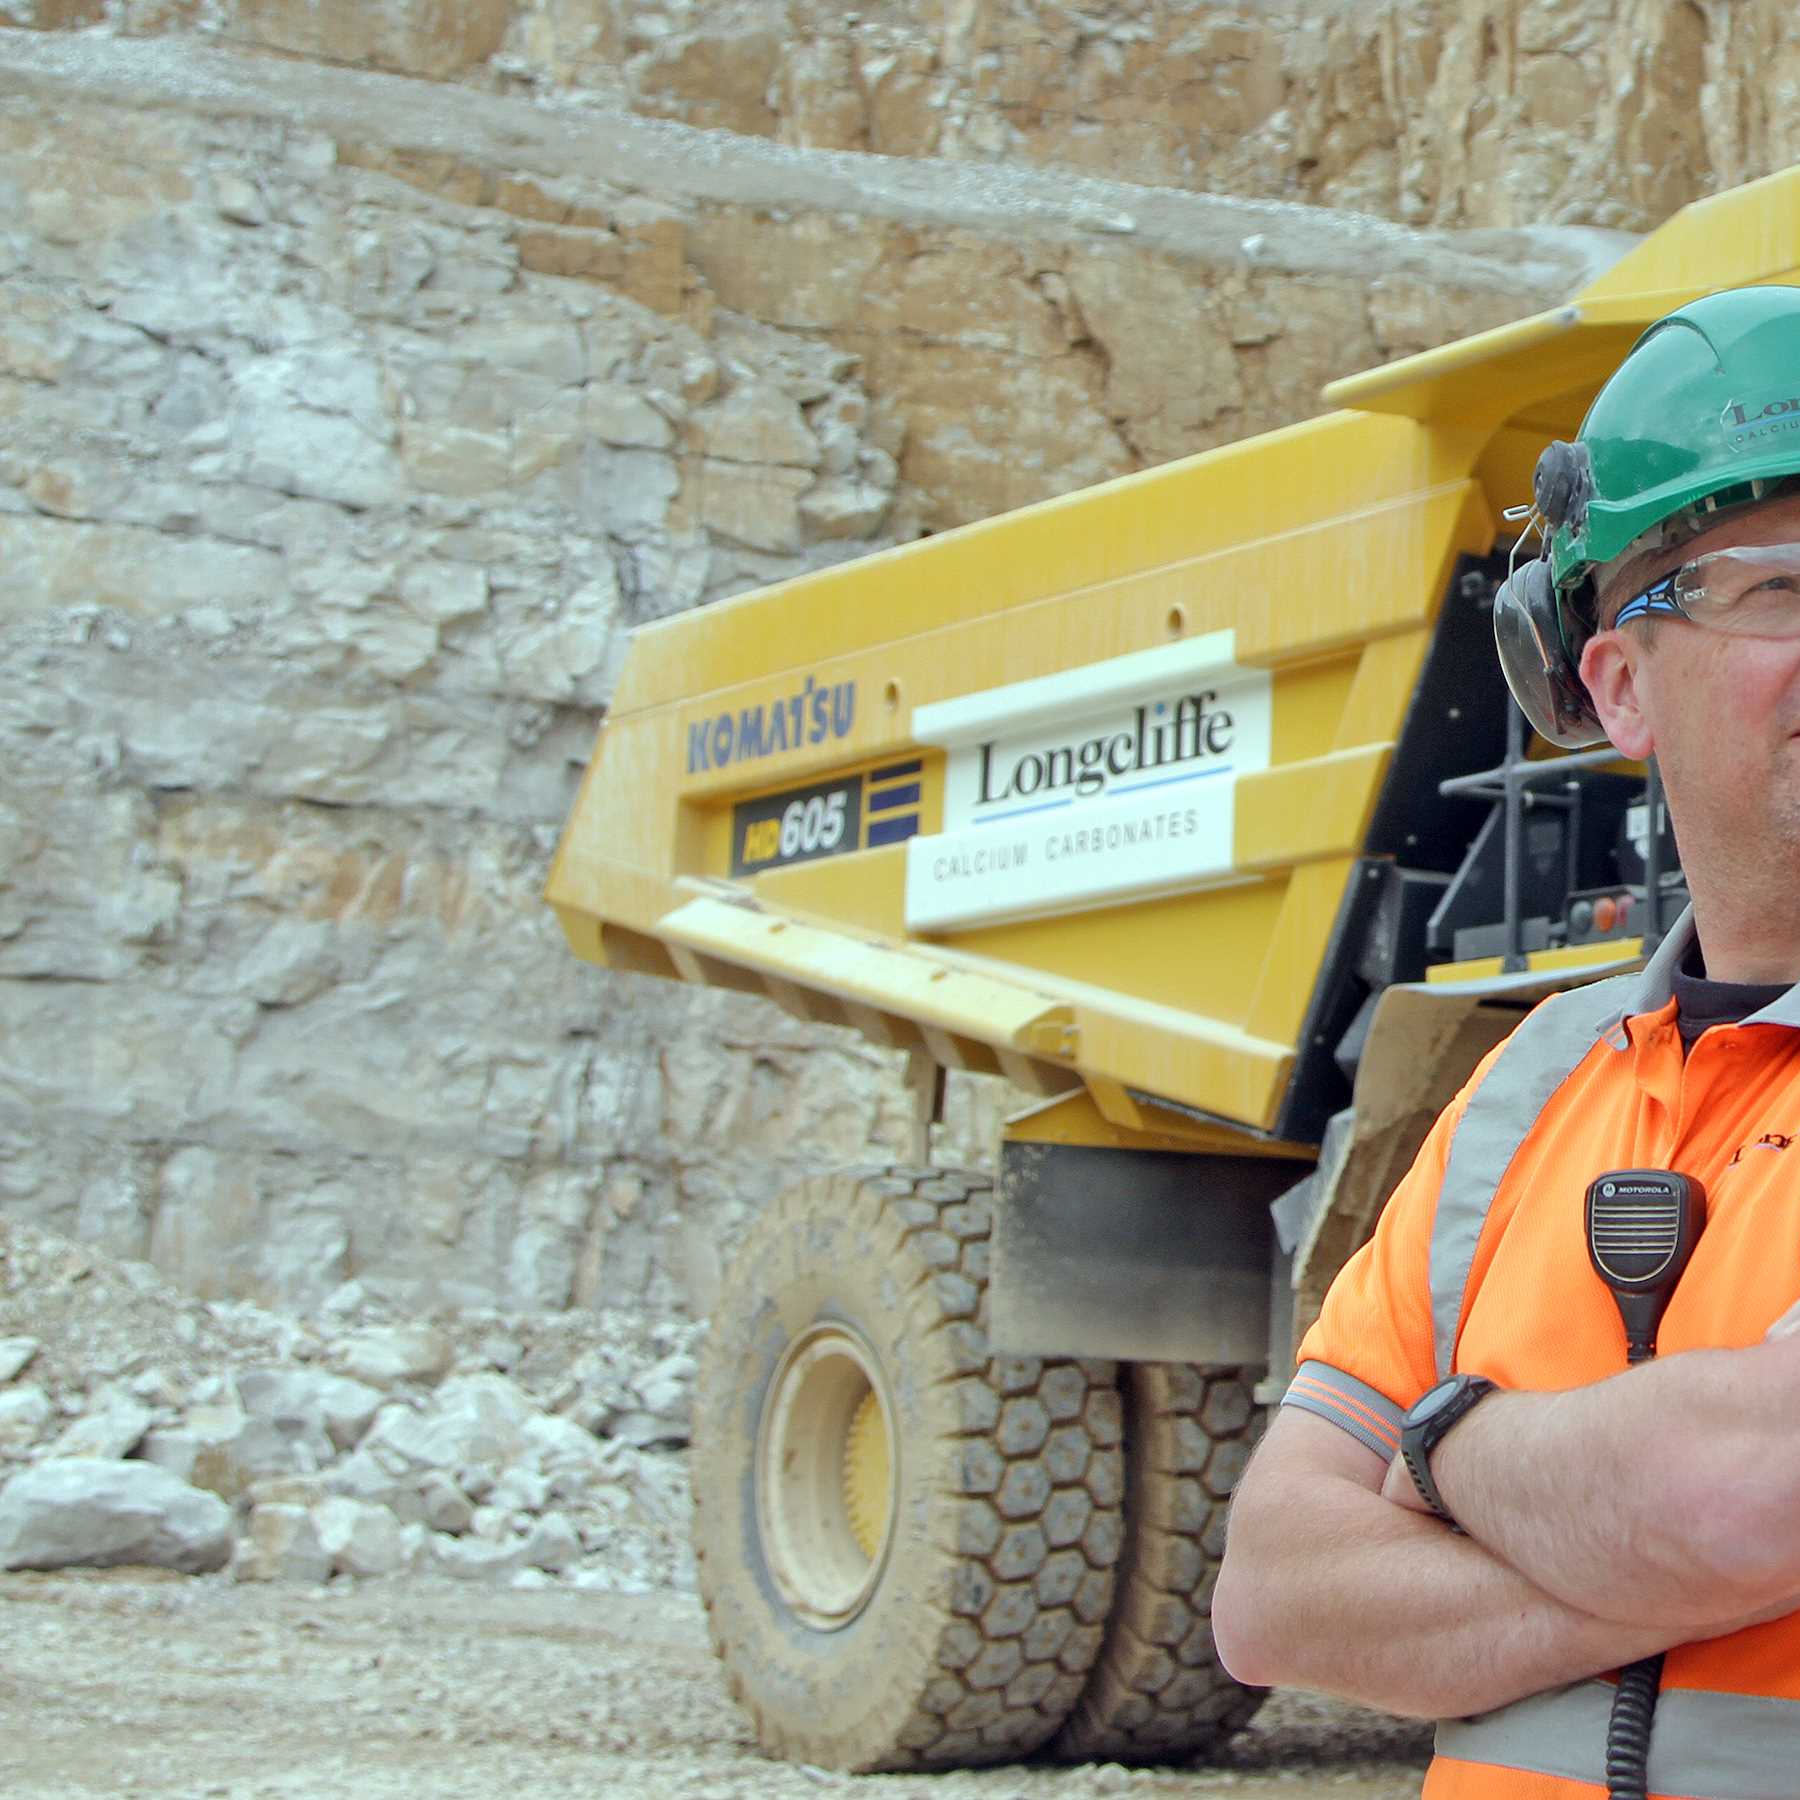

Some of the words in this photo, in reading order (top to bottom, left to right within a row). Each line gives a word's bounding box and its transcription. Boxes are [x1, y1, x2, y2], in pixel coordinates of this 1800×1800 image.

[687, 675, 856, 774] KOMATSU
[974, 690, 1235, 805] Longcliffe
[742, 790, 848, 864] HD605
[933, 843, 1028, 882] CALCIUM
[1045, 808, 1199, 862] CARBONATES
[1618, 1186, 1670, 1194] MOTOROLA
